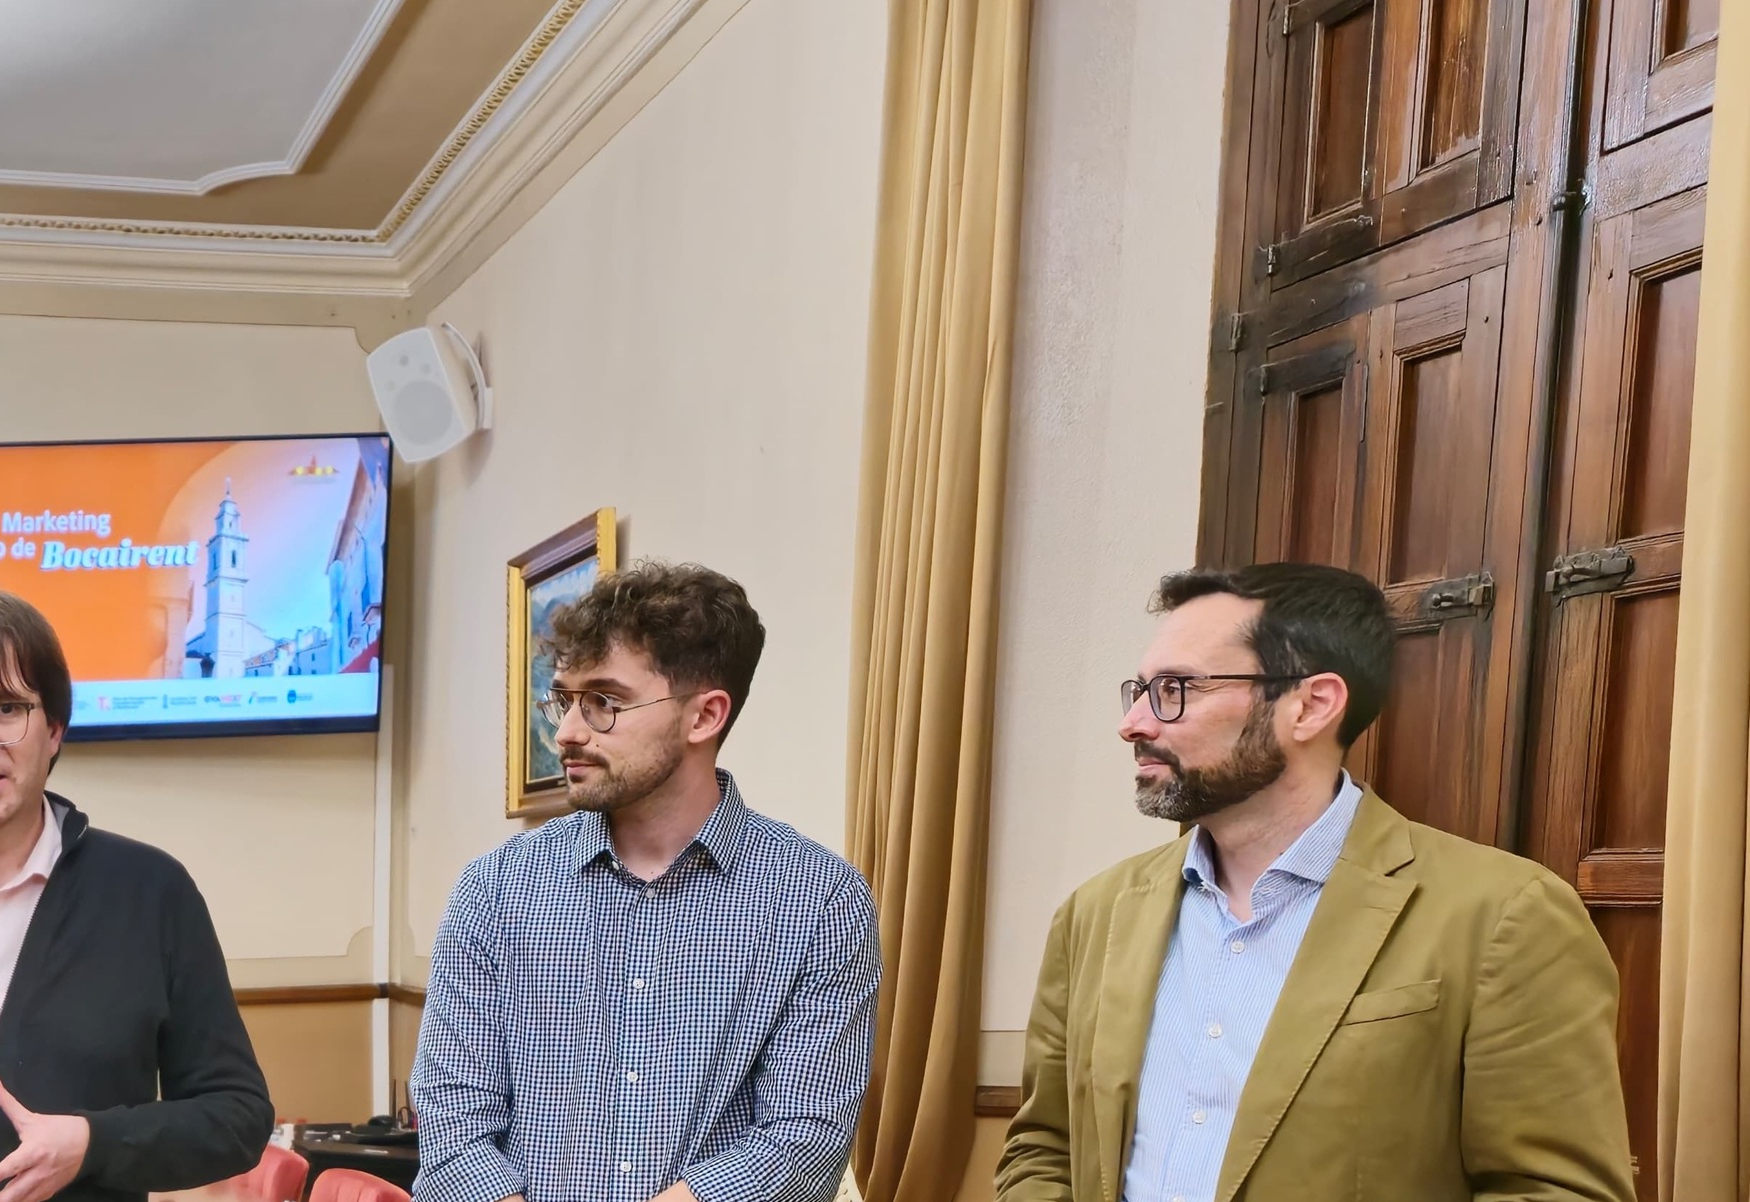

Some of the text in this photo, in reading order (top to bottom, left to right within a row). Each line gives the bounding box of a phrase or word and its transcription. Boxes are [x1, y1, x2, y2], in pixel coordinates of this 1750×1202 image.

[2, 510, 112, 537] Marketing
[11, 537, 36, 559] de
[40, 538, 200, 570] Bocairent
